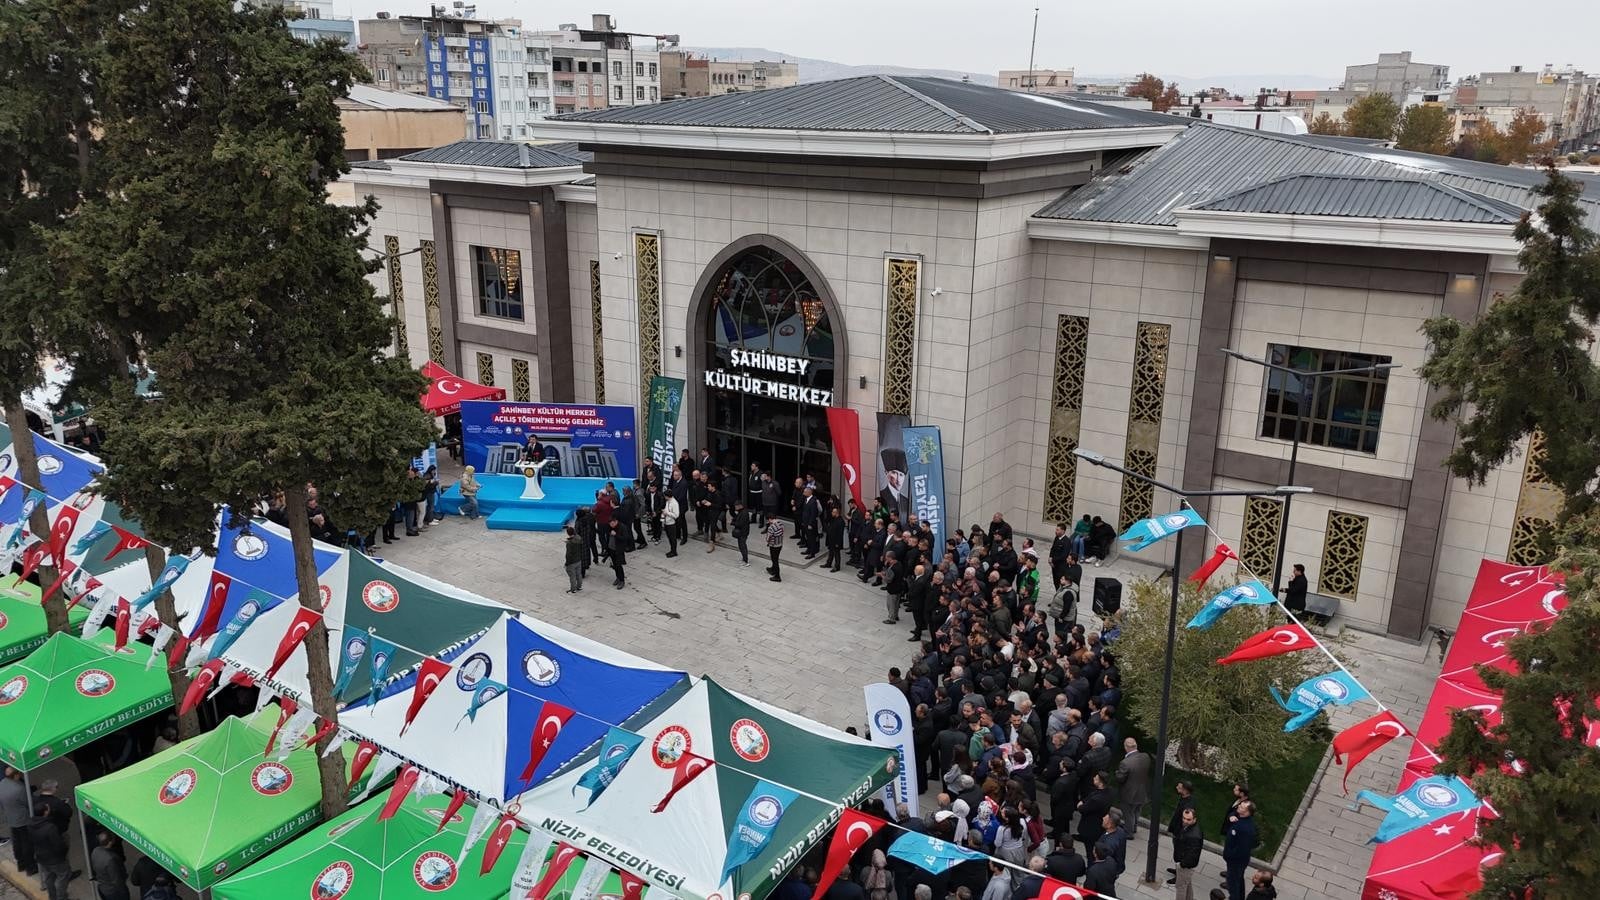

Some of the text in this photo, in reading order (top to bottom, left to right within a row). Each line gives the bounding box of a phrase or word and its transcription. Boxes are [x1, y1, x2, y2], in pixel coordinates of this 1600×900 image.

[731, 349, 809, 375] ŞAHİNBEY
[705, 368, 834, 407] KÜLTÜR MERKEZİ
[494, 416, 517, 424] AÇILIŞ
[556, 417, 570, 425] HOŞ
[572, 417, 604, 426] GELDİNİZ
[537, 407, 564, 415] KÜLTÜR
[566, 408, 596, 416] MERKEZİ
[263, 821, 296, 846] NİZİP
[769, 840, 805, 881] NİZİP
[806, 775, 873, 845] BELEDİYESİ
[541, 817, 687, 891] NİZİP BELEDİYESİ
